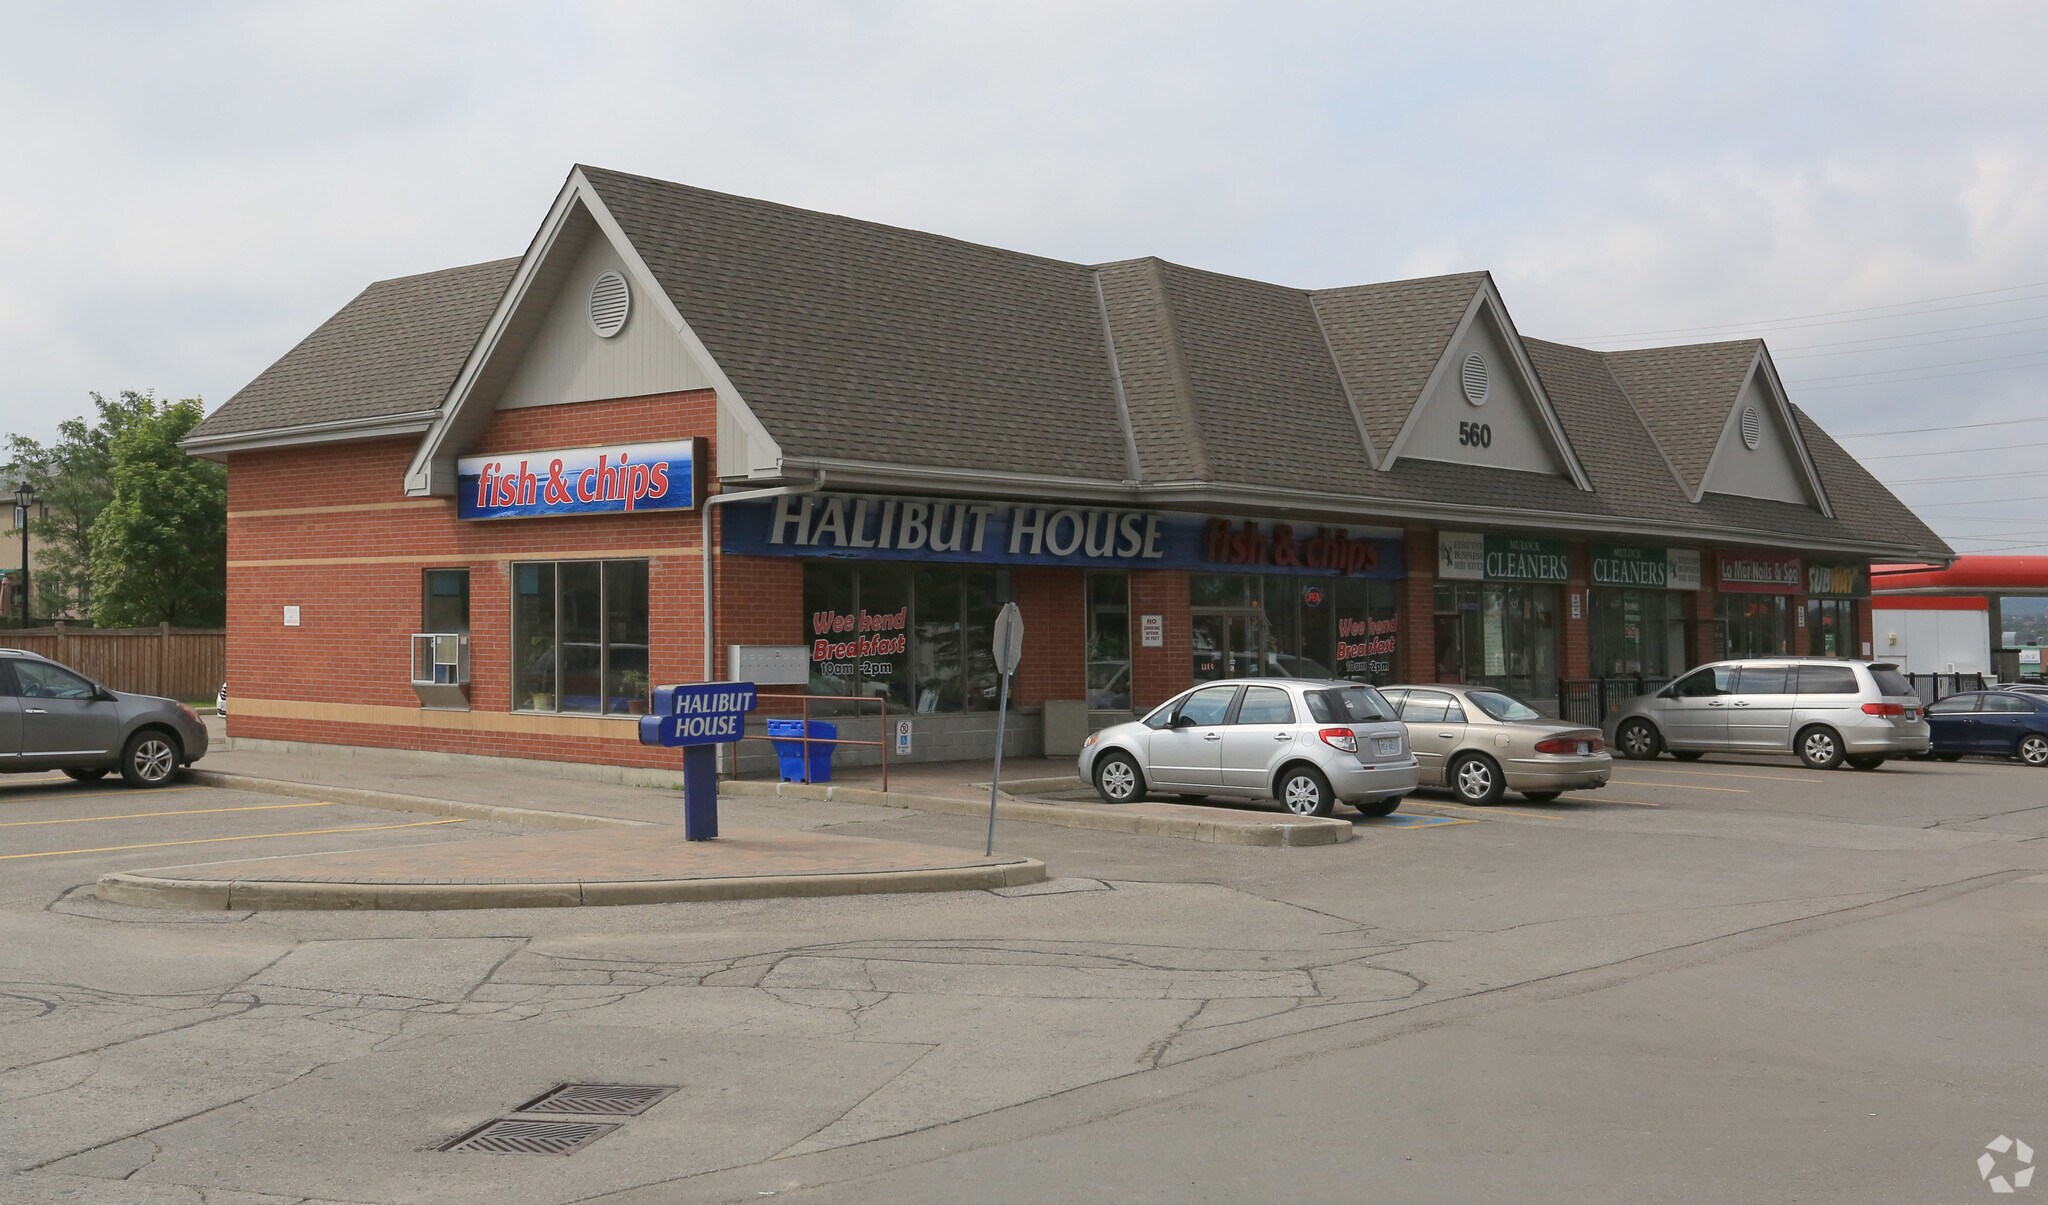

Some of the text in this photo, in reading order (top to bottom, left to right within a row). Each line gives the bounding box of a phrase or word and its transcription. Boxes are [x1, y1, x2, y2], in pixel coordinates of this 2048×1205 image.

[1460, 421, 1491, 448] 560
[477, 452, 669, 511] fish & chips
[769, 495, 1165, 559] HALIBUT HOUSE
[1205, 518, 1381, 577] fish & chips
[1454, 551, 1483, 560] BUSINESS
[1510, 540, 1541, 551] MULOCK
[1486, 551, 1568, 580] CLEANERS
[1593, 558, 1665, 585] CLEANERS
[1722, 559, 1732, 578] La
[1734, 560, 1750, 579] Mer
[1753, 560, 1773, 580] Nails
[1784, 562, 1798, 586] Spa
[1808, 567, 1859, 594] SUBWAY
[813, 633, 906, 661] Breakfast
[675, 692, 754, 714] HALIBUT
[674, 715, 737, 738] HOUSE
